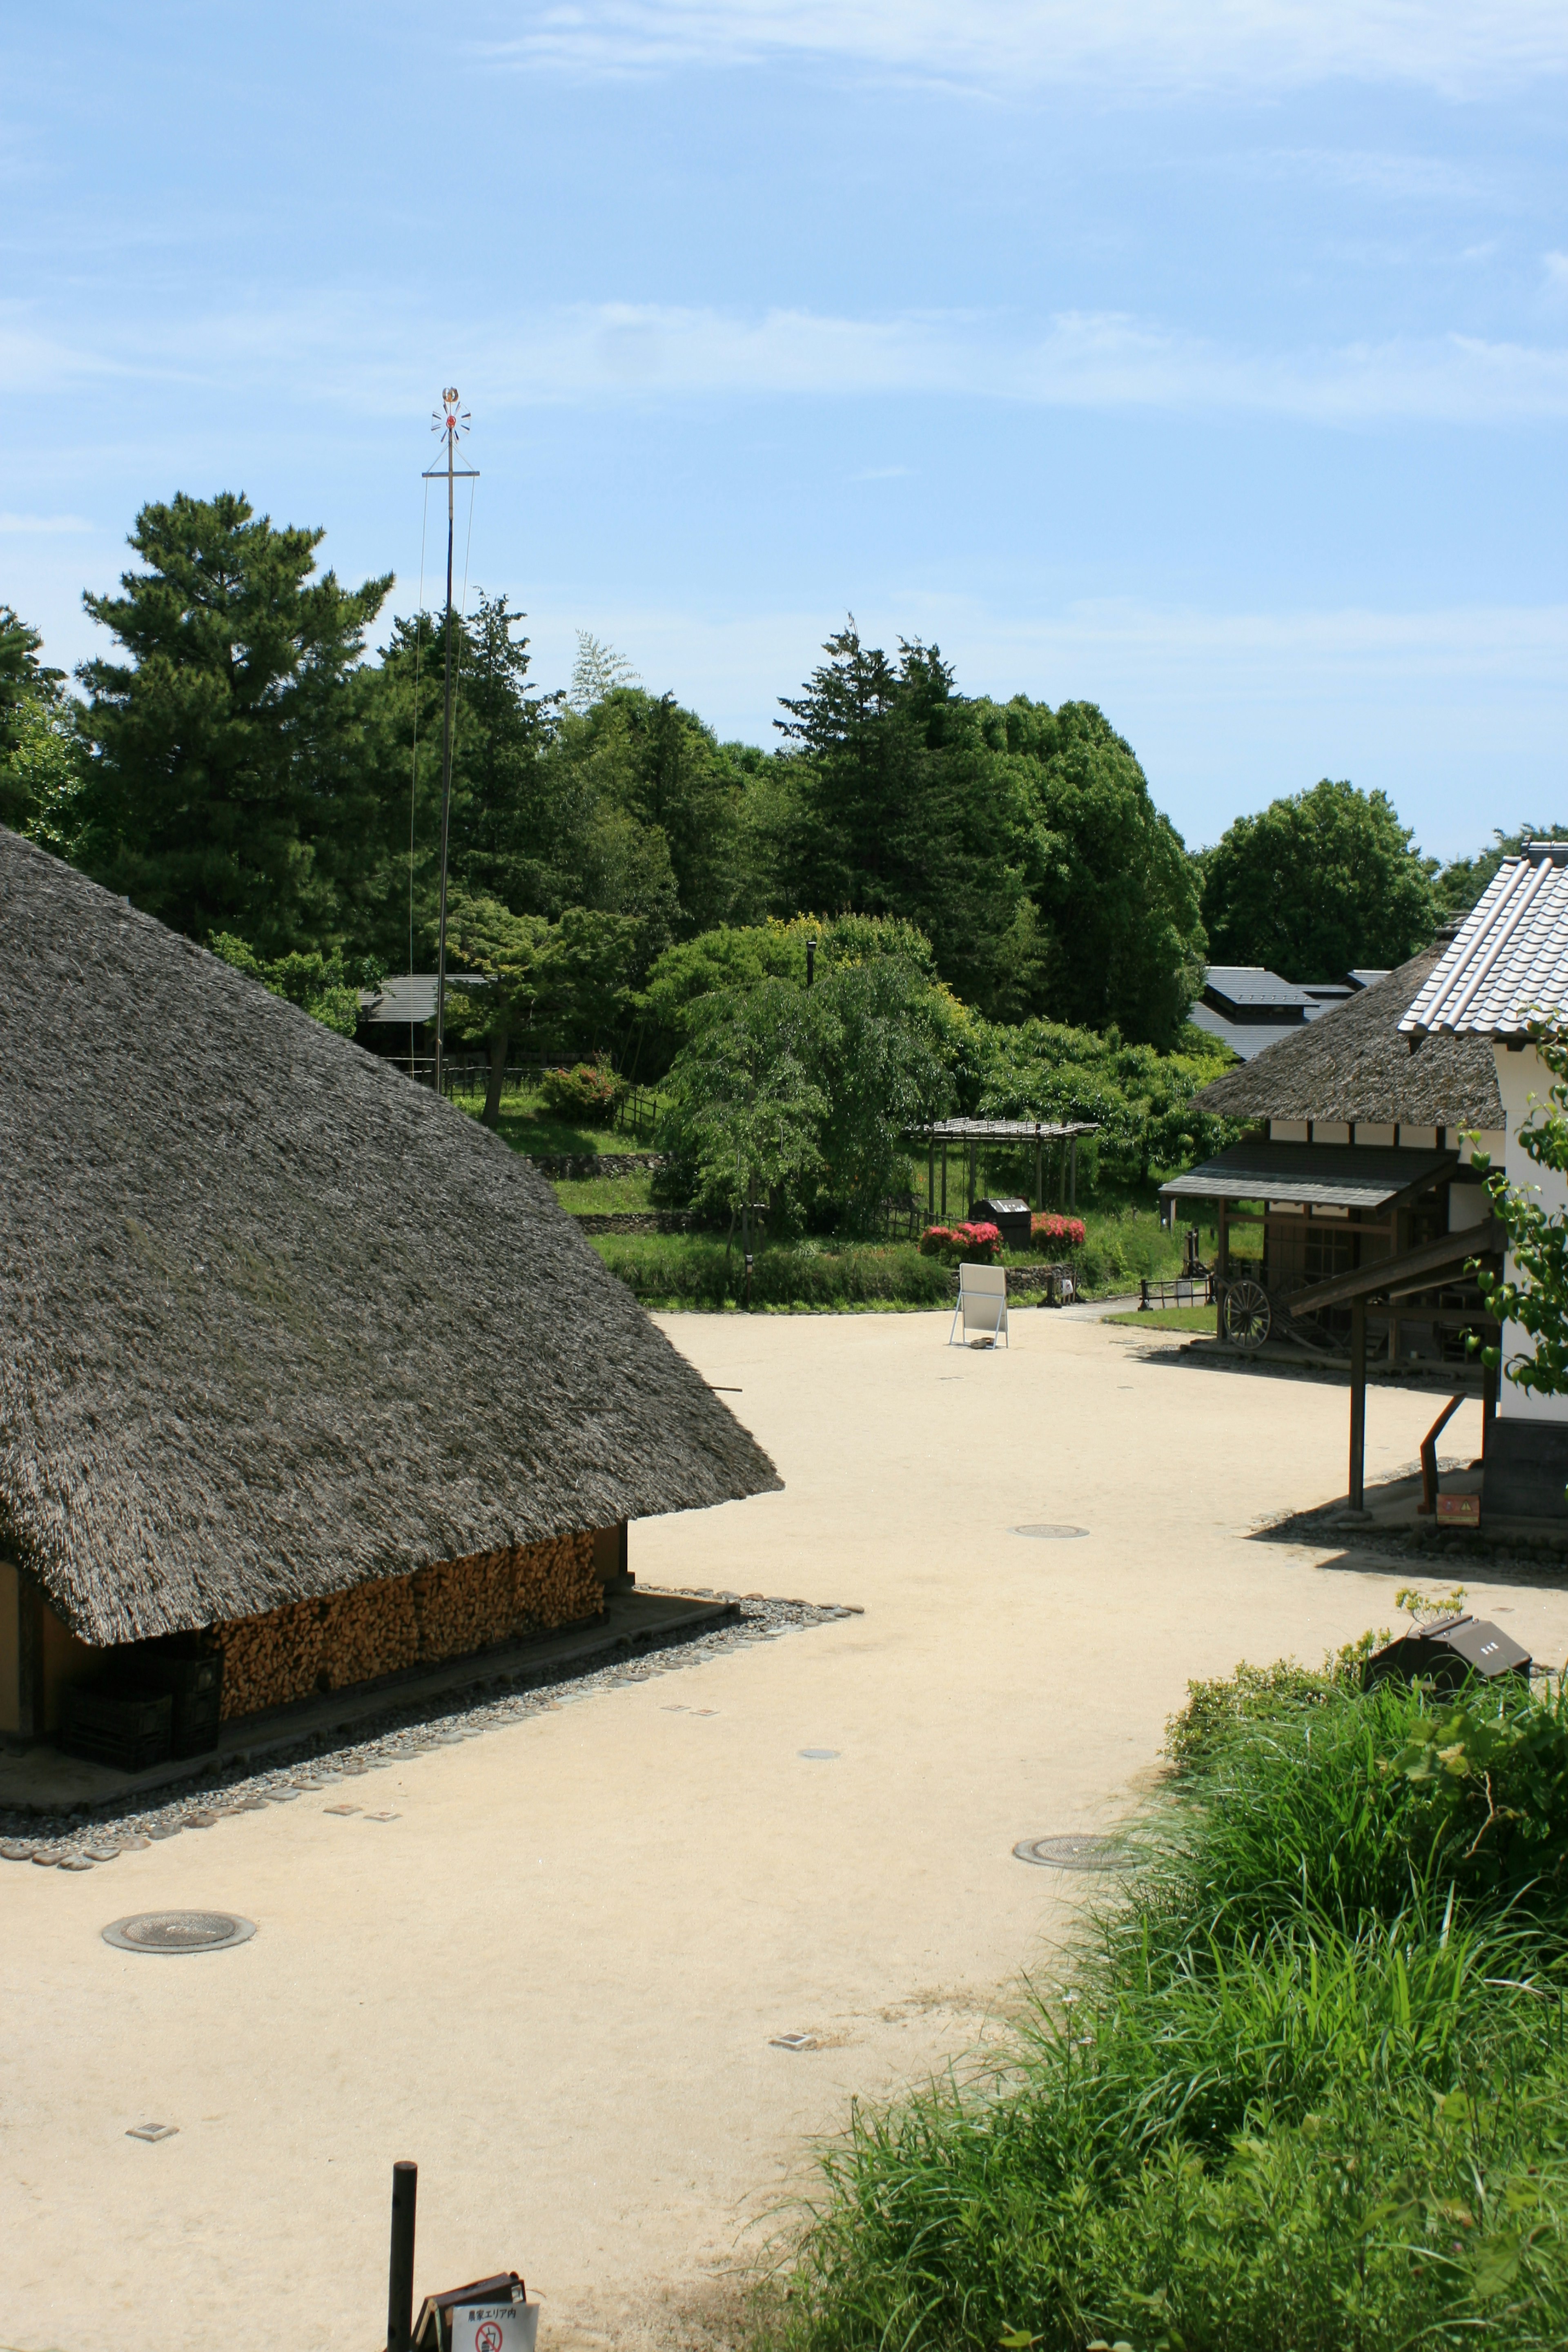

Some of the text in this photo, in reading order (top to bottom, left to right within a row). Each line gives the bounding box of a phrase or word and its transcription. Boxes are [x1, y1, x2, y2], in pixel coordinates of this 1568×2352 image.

[468, 2308, 516, 2322] 農家エリア内
